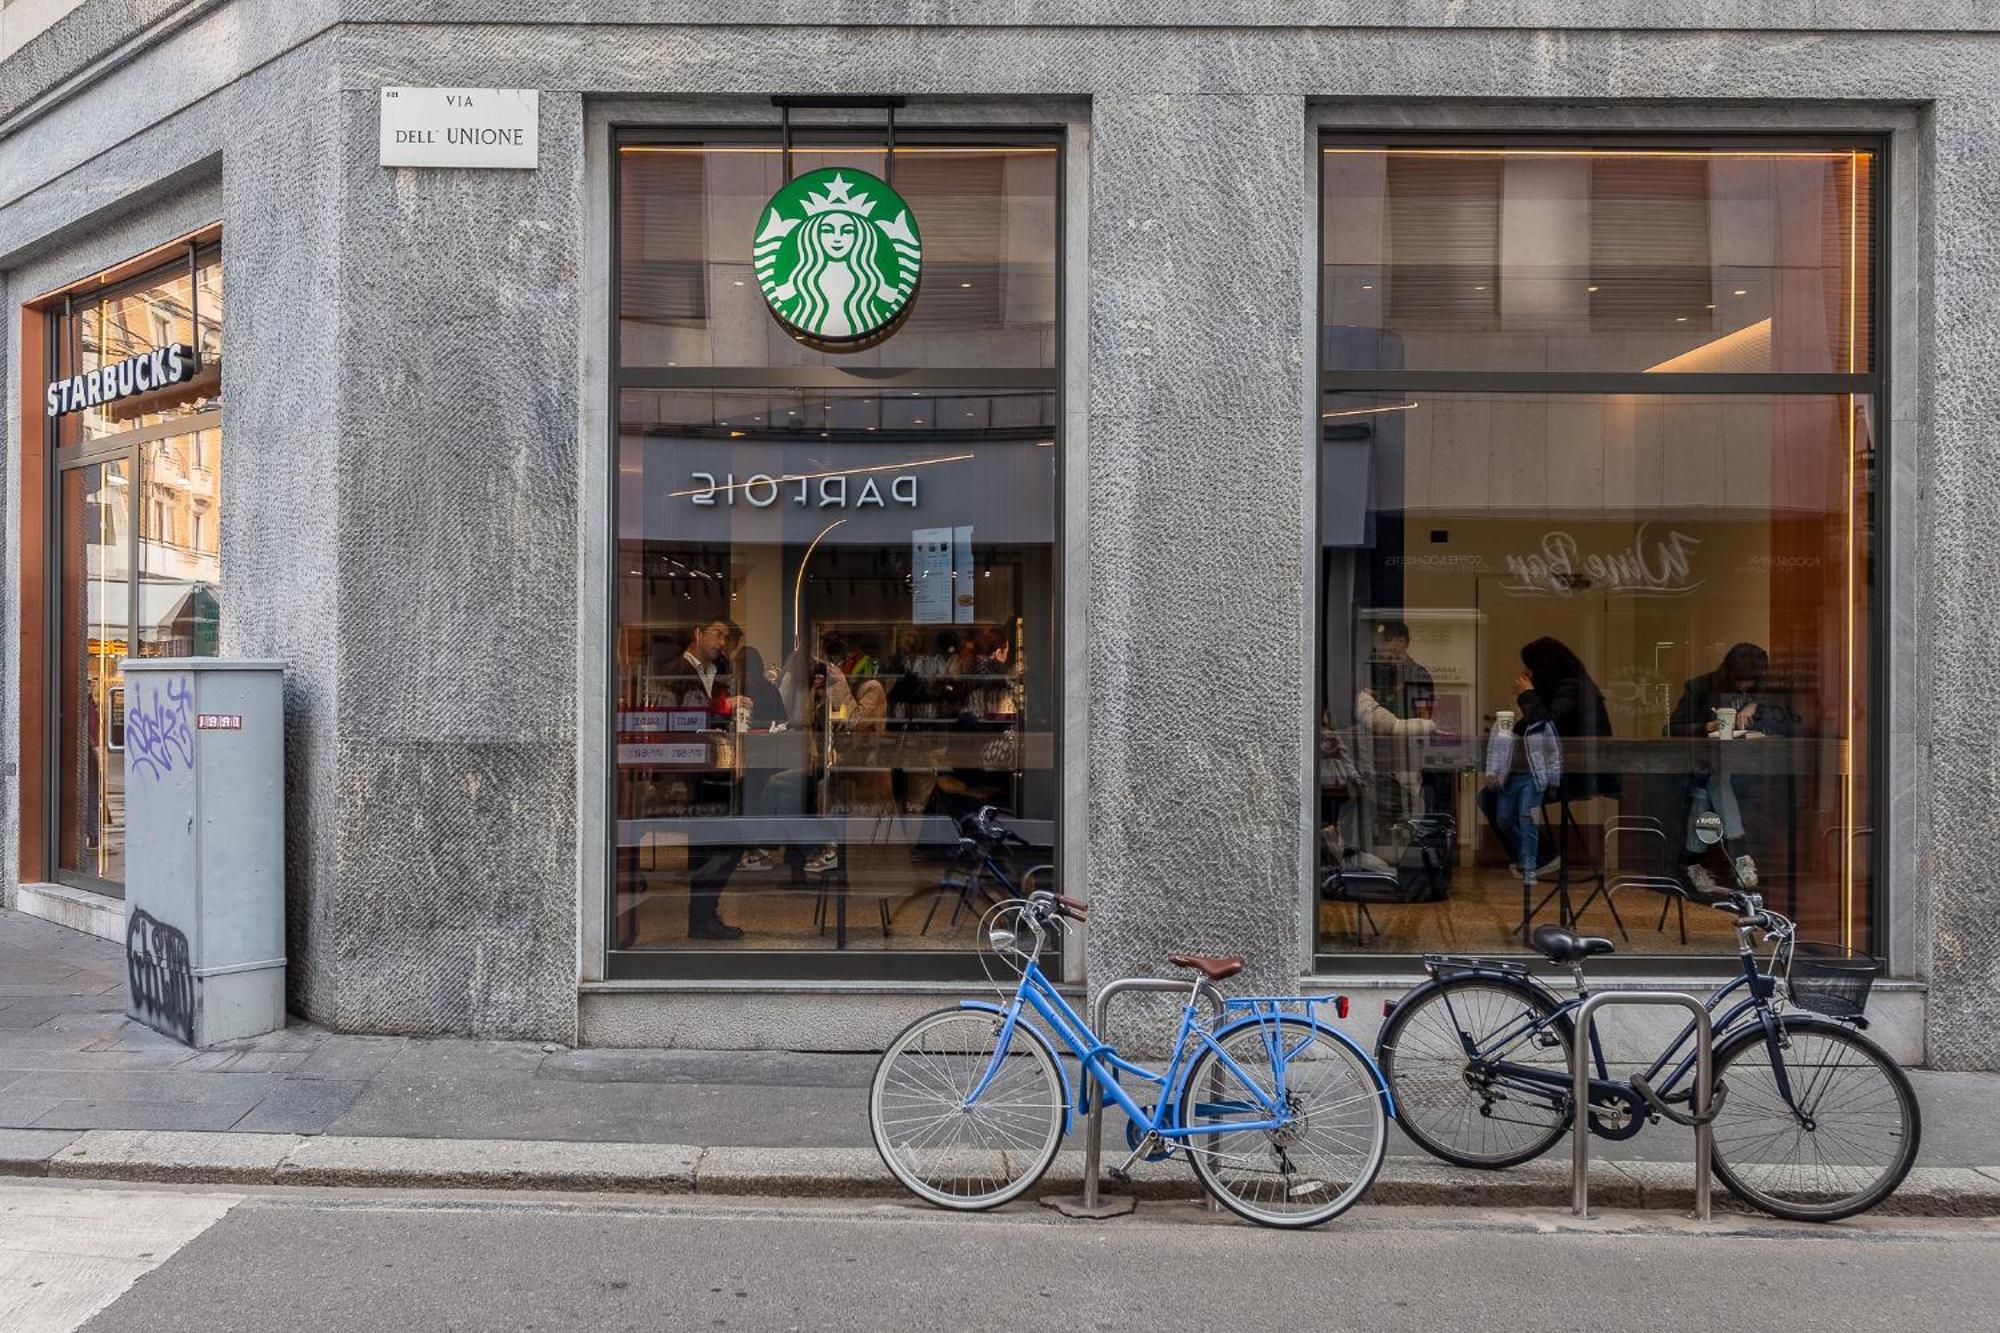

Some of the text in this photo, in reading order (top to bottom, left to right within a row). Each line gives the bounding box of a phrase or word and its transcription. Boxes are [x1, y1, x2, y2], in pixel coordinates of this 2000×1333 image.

[446, 95, 473, 107] VIA
[447, 127, 524, 146] UNIONE
[47, 343, 183, 417] STARBUCKS
